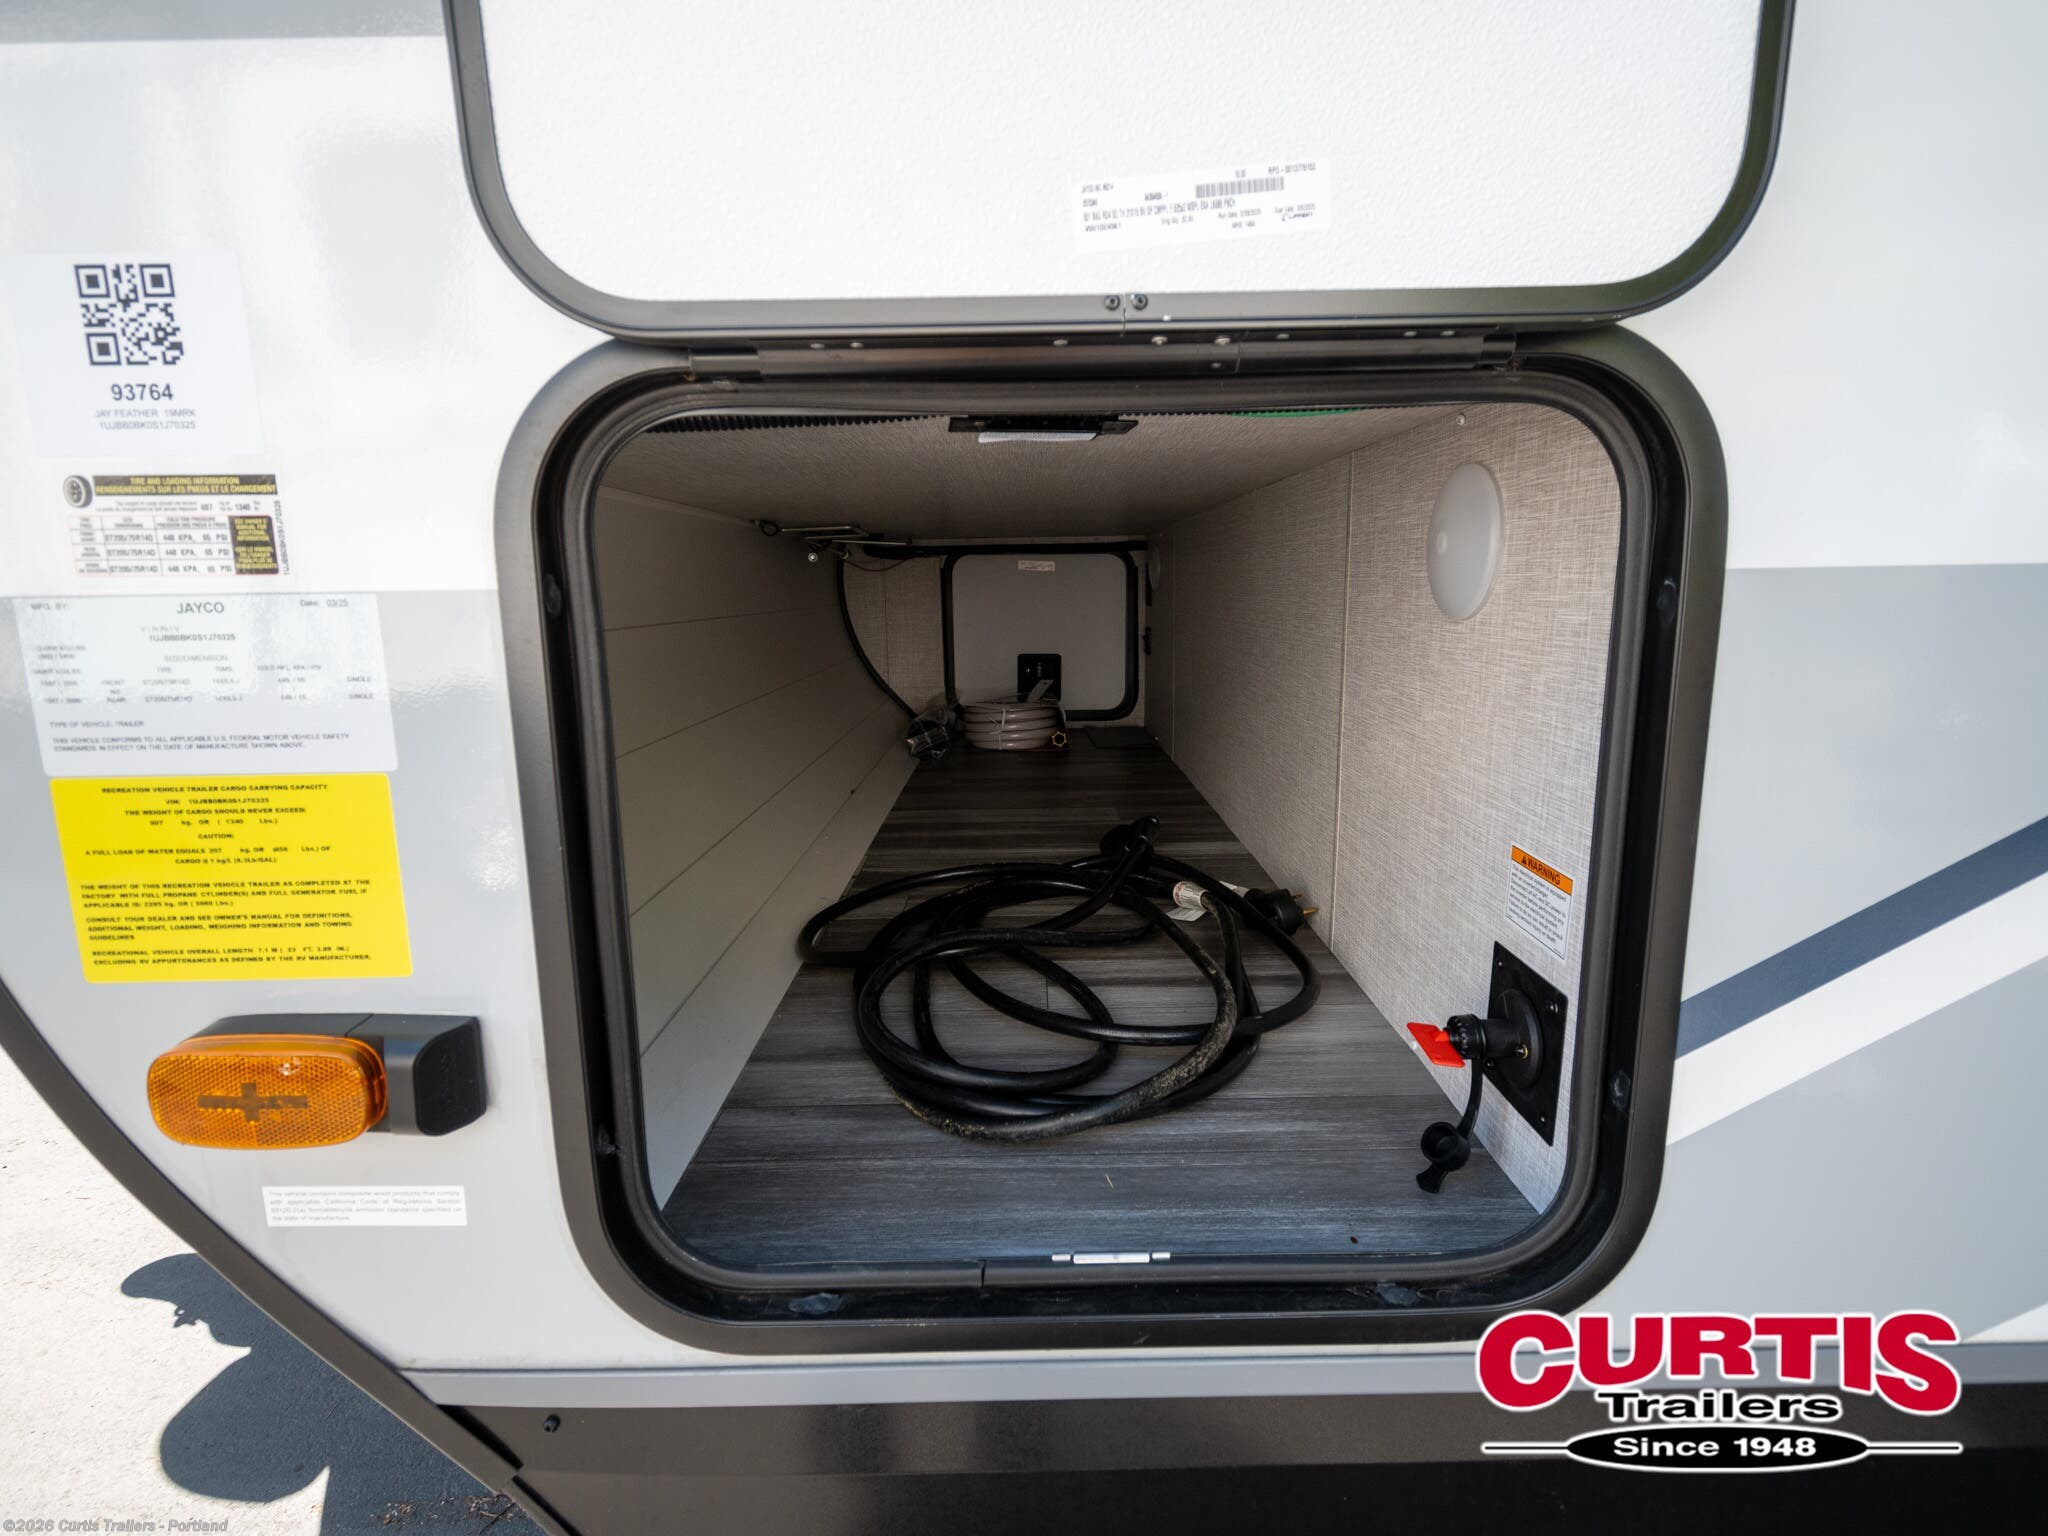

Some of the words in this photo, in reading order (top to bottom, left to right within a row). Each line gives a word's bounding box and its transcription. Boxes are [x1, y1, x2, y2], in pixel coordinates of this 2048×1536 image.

[111, 384, 173, 401] 93764
[130, 477, 145, 485] TIRE
[147, 477, 161, 485] AND
[162, 477, 192, 485] LOADING
[193, 477, 240, 485] INFORMATION
[177, 602, 225, 614] JAYCO
[115, 720, 144, 728] TRAILER
[1527, 858, 1561, 885] WARNING
